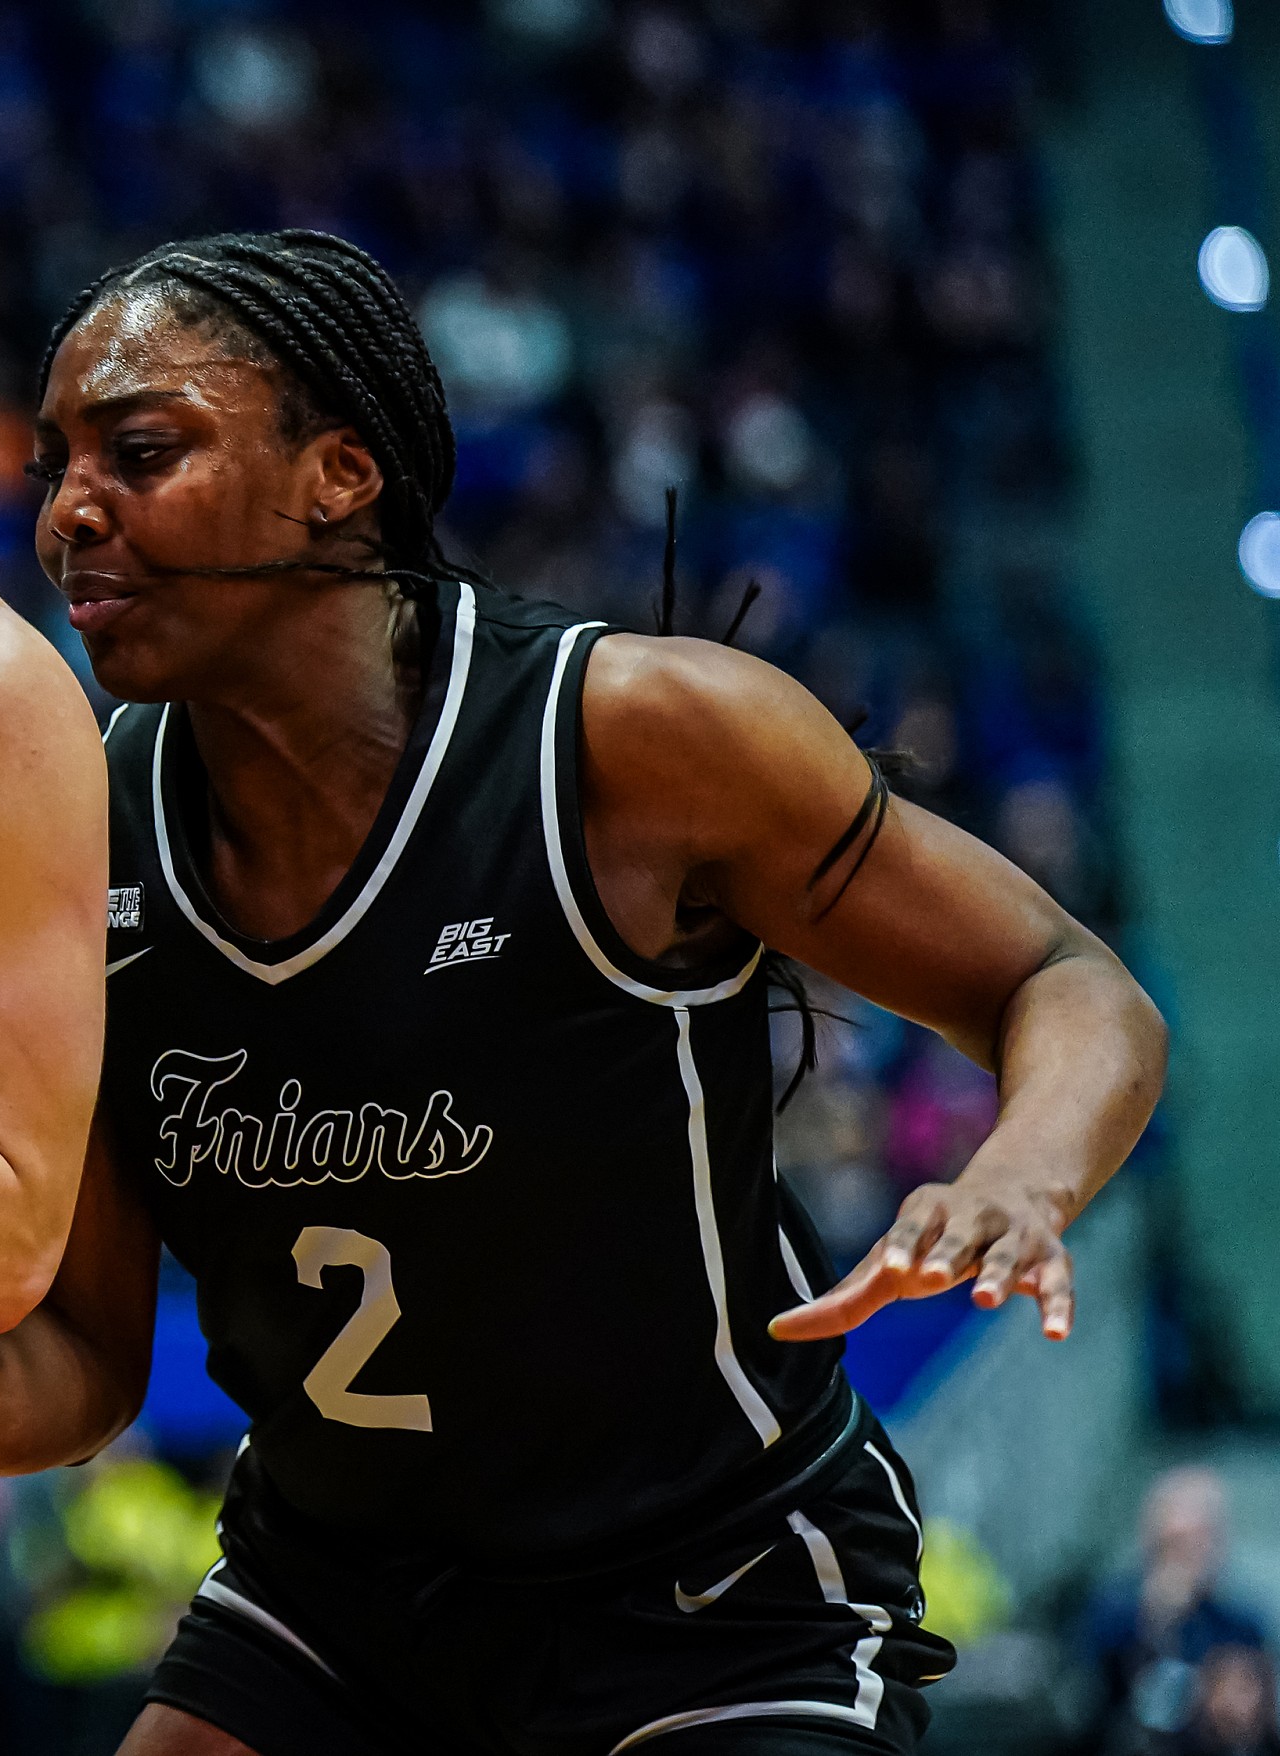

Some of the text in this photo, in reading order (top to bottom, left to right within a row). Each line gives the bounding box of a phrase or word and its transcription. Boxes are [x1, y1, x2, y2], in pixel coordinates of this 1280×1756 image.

[108, 911, 140, 928] NGE
[437, 917, 494, 944] BIG
[429, 933, 512, 963] EAST
[151, 1049, 493, 1187] Friars
[291, 1226, 433, 1432] 2
